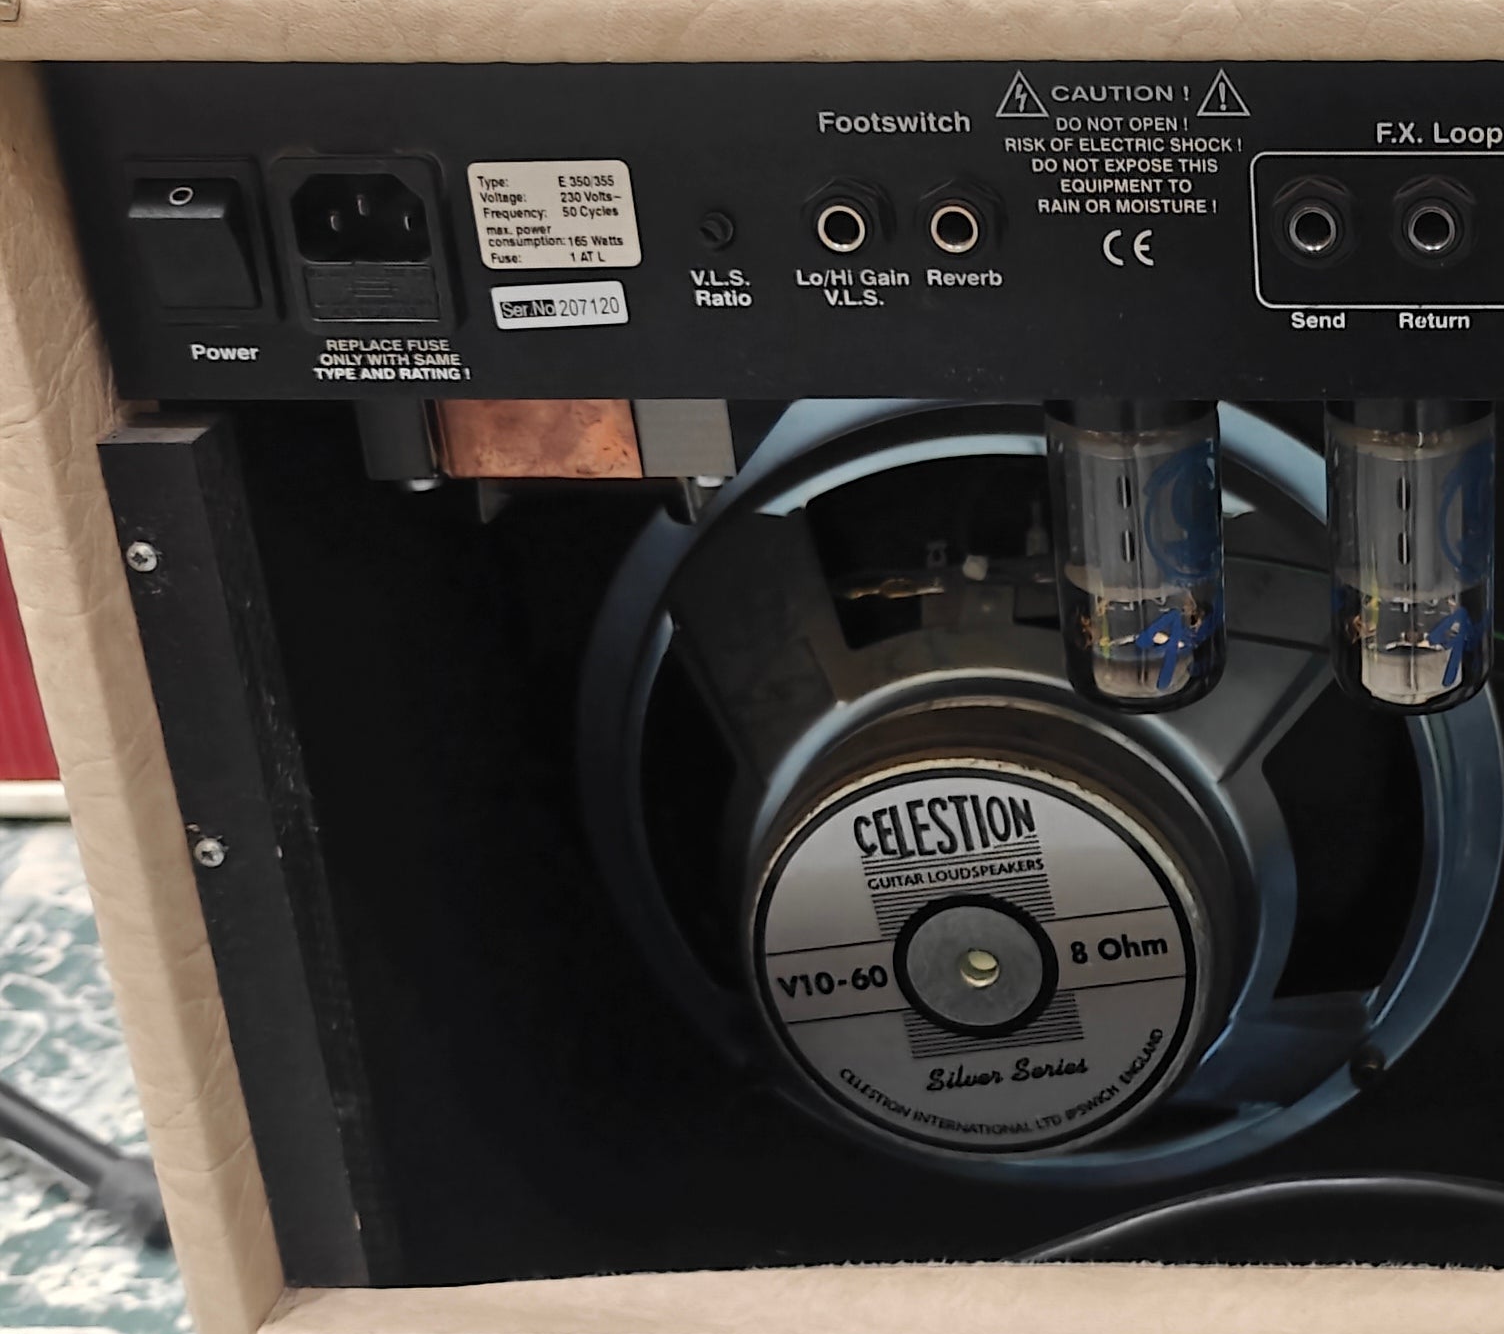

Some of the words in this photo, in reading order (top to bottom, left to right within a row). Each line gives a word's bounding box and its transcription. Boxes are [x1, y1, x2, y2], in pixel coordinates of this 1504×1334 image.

[1051, 85, 1173, 102] CAUTION
[818, 111, 971, 134] Footswitch
[1056, 117, 1082, 132] DO
[1087, 117, 1124, 132] NOT
[1129, 117, 1178, 132] OPEN
[1376, 122, 1423, 144] F.X.
[1433, 122, 1504, 149] Loop
[1005, 138, 1046, 152] RISK
[1050, 138, 1074, 152] OF
[1079, 138, 1165, 152] ELECTRIC
[1170, 138, 1232, 152] SHOCK
[1032, 158, 1057, 173] DO
[1063, 158, 1099, 173] NOT
[1104, 158, 1173, 173] EXPOSE
[1178, 158, 1218, 173] THIS
[477, 176, 508, 190] Type:
[558, 176, 566, 187] E
[1060, 179, 1163, 194] EQUIPMENT
[1168, 179, 1192, 193] TO
[479, 192, 527, 205] Voltage:
[560, 192, 581, 202] 230
[1038, 199, 1080, 214] RAIN
[1085, 199, 1111, 214] OR
[1116, 199, 1207, 214] MOISTURE
[483, 207, 547, 220] Frequency:
[562, 206, 577, 217] 50
[580, 206, 619, 219] Cycles
[486, 226, 512, 235] max.
[517, 225, 551, 237] power
[488, 237, 565, 248] consumption:
[592, 236, 624, 246] Watts
[491, 253, 522, 263] Fuse:
[580, 251, 594, 262] AT
[690, 270, 751, 288] V.L.S.
[796, 269, 853, 288] Lo/Hi
[859, 269, 910, 288] Gain
[927, 269, 1003, 287] Reverb
[558, 297, 620, 316] 207120
[695, 290, 753, 308] Ratio
[824, 290, 885, 307] V.L.S.
[1291, 312, 1346, 329] Send
[1399, 312, 1471, 329] Return
[190, 344, 260, 361] Power
[326, 339, 402, 352] REPLACE
[407, 339, 450, 352] FUSE
[319, 353, 363, 367] ONLY
[367, 353, 410, 366] WITH
[414, 353, 461, 366] SAME
[313, 367, 357, 381] TYPE
[360, 367, 397, 380] AND
[400, 367, 460, 380] RATING
[853, 794, 1036, 859] CELESTION
[867, 870, 925, 891] GUITAR
[928, 858, 1045, 885] LOUDSPEAKERS
[1071, 942, 1088, 964] 8
[1098, 935, 1169, 961] Ohm
[777, 965, 889, 998] V10-60
[840, 1067, 911, 1117] CELESTION
[912, 1109, 1033, 1134] INTERNATIONAL
[1036, 1114, 1062, 1131] LTD
[1065, 1083, 1120, 1122] IPSWICH
[1120, 1027, 1164, 1085] ENGLAND
[926, 1063, 1003, 1091] Silver
[1011, 1056, 1088, 1082] Series
